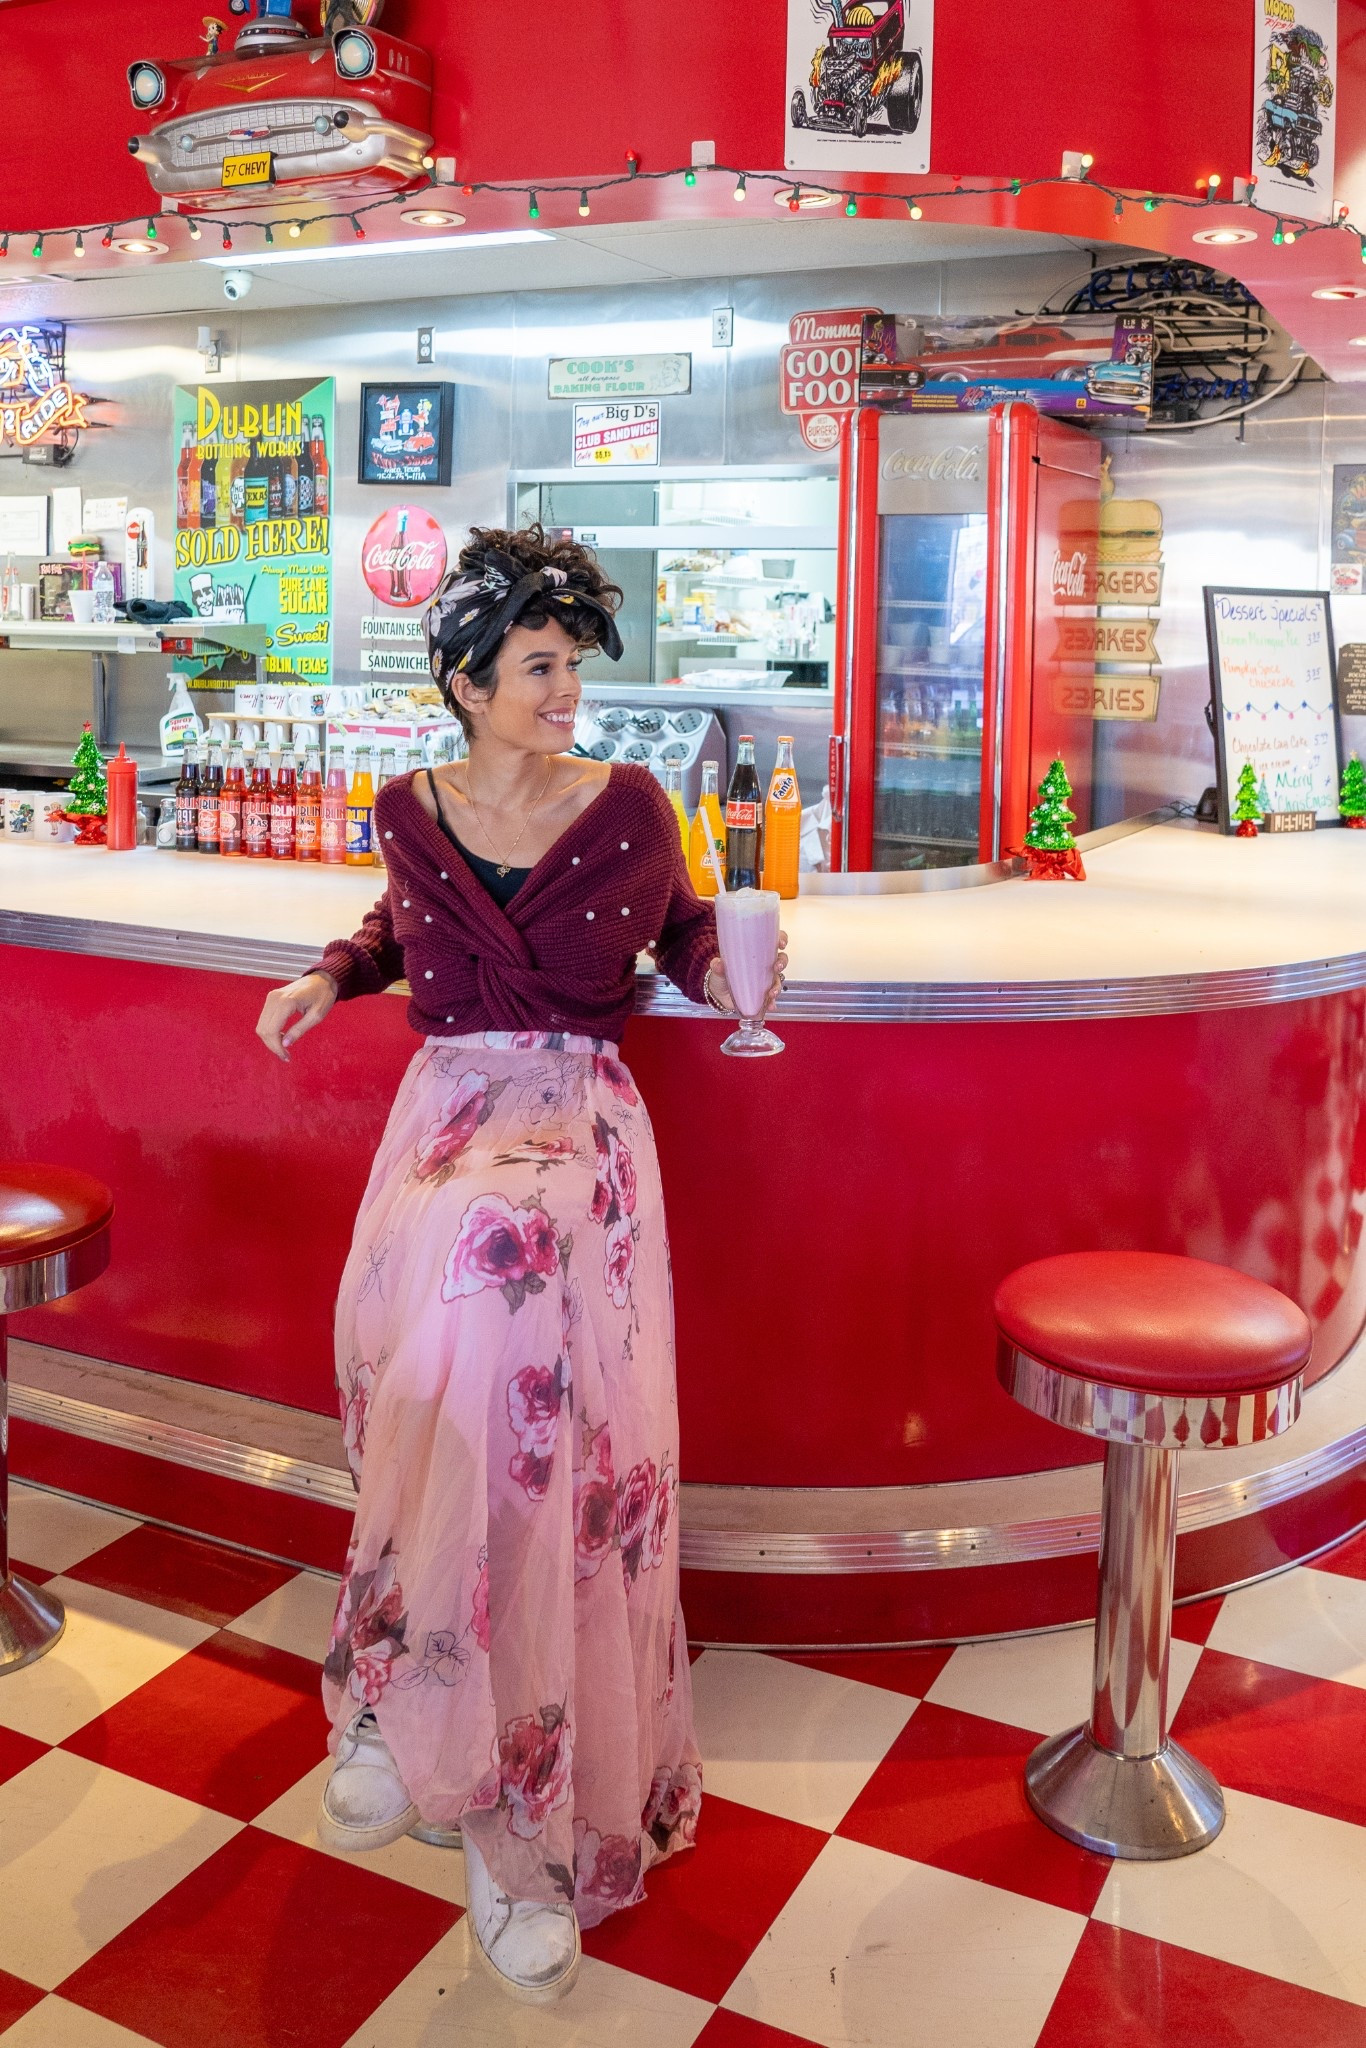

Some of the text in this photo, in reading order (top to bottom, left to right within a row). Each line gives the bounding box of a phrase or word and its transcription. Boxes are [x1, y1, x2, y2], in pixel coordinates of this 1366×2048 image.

[1264, 0, 1295, 22] MOPAR
[224, 160, 268, 178] 57 CHEVY
[566, 359, 635, 375] COOK'S
[553, 381, 645, 394] BAKING FLOUR
[21, 390, 68, 440] RIDE
[197, 385, 303, 441] DUBLIN
[576, 416, 589, 428] Try
[605, 405, 630, 421] Big
[634, 405, 656, 418] D's
[575, 420, 658, 449] CLUB SANDWICH
[808, 424, 838, 437] BURGERS
[195, 440, 302, 460] BOTTLING WORKS
[175, 516, 330, 568] SOLD HERE!
[365, 541, 439, 574] Coca-Cola
[261, 564, 328, 576] Always Made With
[279, 577, 328, 592] PURE CANE
[1095, 570, 1159, 594] RGERS
[279, 591, 328, 614] SUGAR
[1221, 597, 1318, 630] Dessert Specials
[275, 621, 330, 647] Sweet!
[362, 621, 405, 635] FOUNTAIN
[1093, 628, 1147, 652] AKES
[296, 656, 327, 674] TEXAS
[367, 654, 430, 670] SANDWICHE
[1223, 656, 1257, 677] Pumpkin
[371, 688, 387, 699] ICE
[1093, 686, 1146, 712] RIES
[169, 717, 193, 726] Spray
[171, 724, 190, 732] Nine
[1232, 736, 1271, 754] Chocolate
[772, 776, 794, 800] Fanta
[1275, 770, 1313, 793] Merry
[176, 796, 199, 809] UBLIN
[242, 801, 270, 814] UBLIN
[271, 804, 295, 817] UBLIN
[1277, 791, 1334, 813] Christmas
[296, 806, 320, 818] UBLIN
[321, 808, 346, 820] UBLIN
